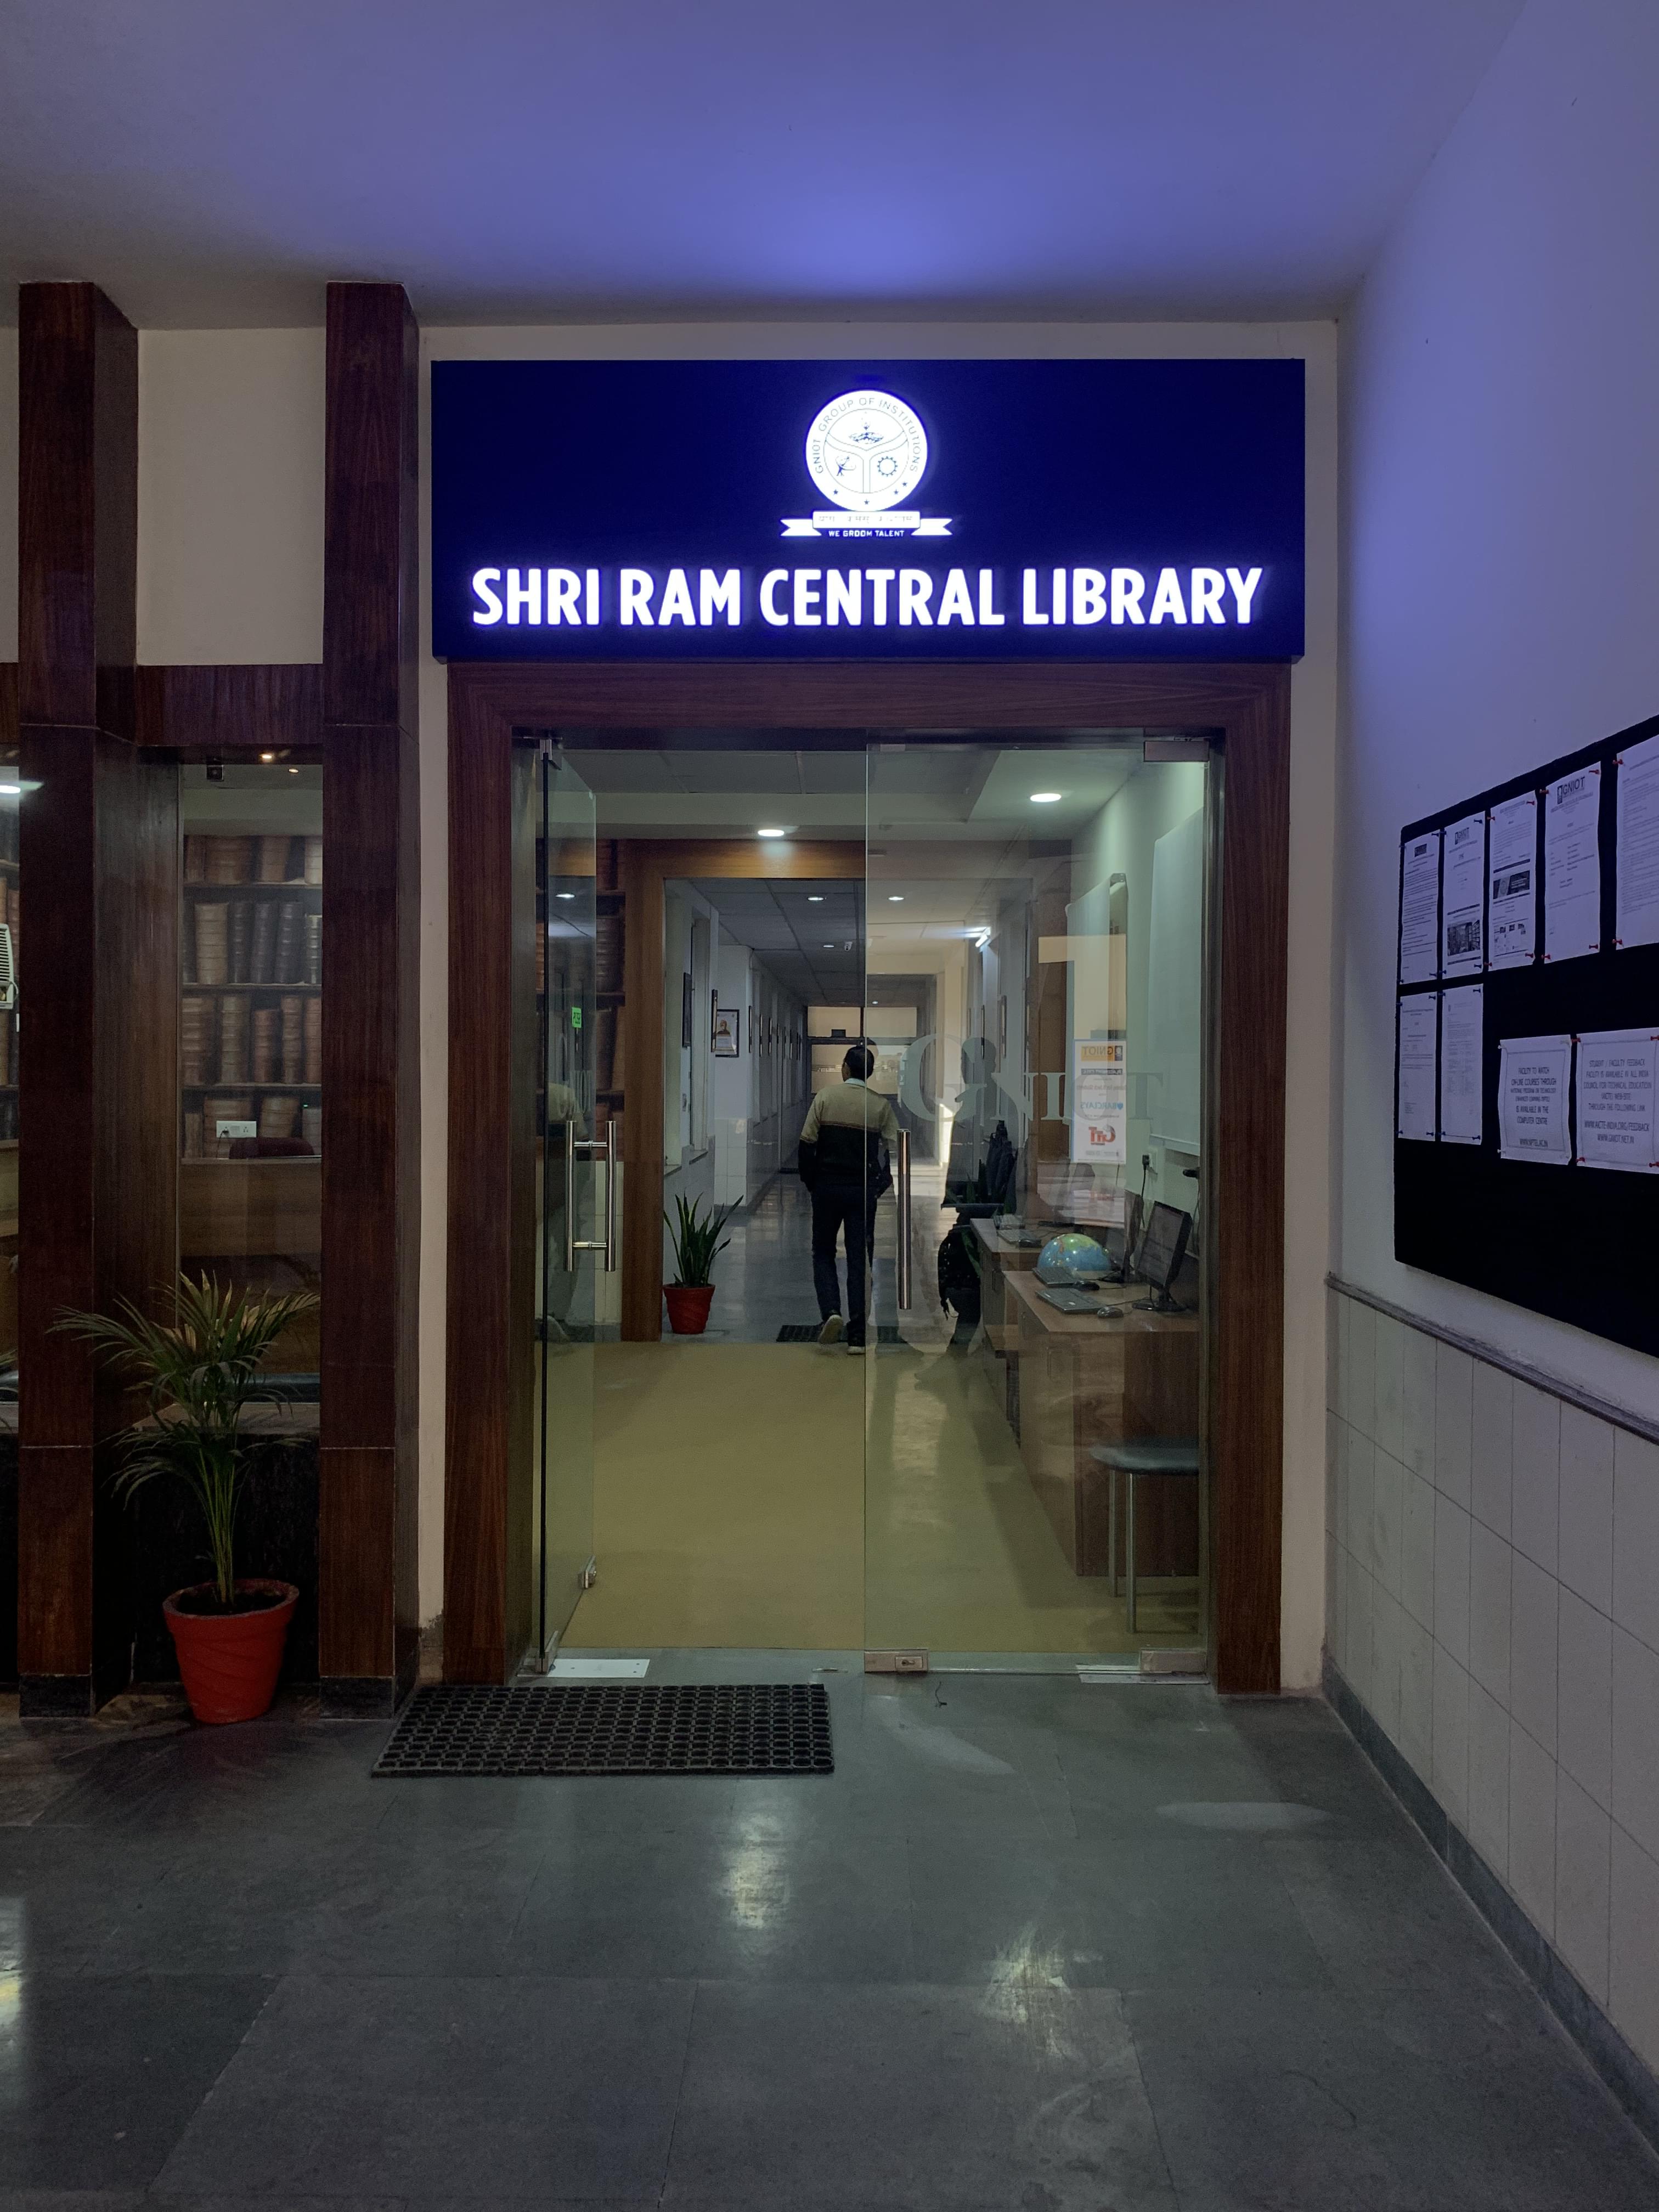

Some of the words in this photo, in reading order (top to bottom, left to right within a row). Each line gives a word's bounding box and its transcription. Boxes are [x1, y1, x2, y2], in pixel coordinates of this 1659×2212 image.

[811, 439, 824, 474] GNIOT
[818, 399, 854, 432] GROUP
[859, 397, 876, 406] OF
[878, 398, 922, 472] INSTITUTIONS
[472, 568, 600, 626] SHRI
[620, 568, 741, 626] RAM
[760, 569, 1005, 626] CENTRAL
[1023, 568, 1262, 625] LIBRARY
[1563, 776, 1585, 795] GNIOT
[1609, 1059, 1625, 1067] FACULTY
[1627, 1058, 1645, 1066] FEEDBACK
[1517, 1116, 1534, 1124] COMPUTER
